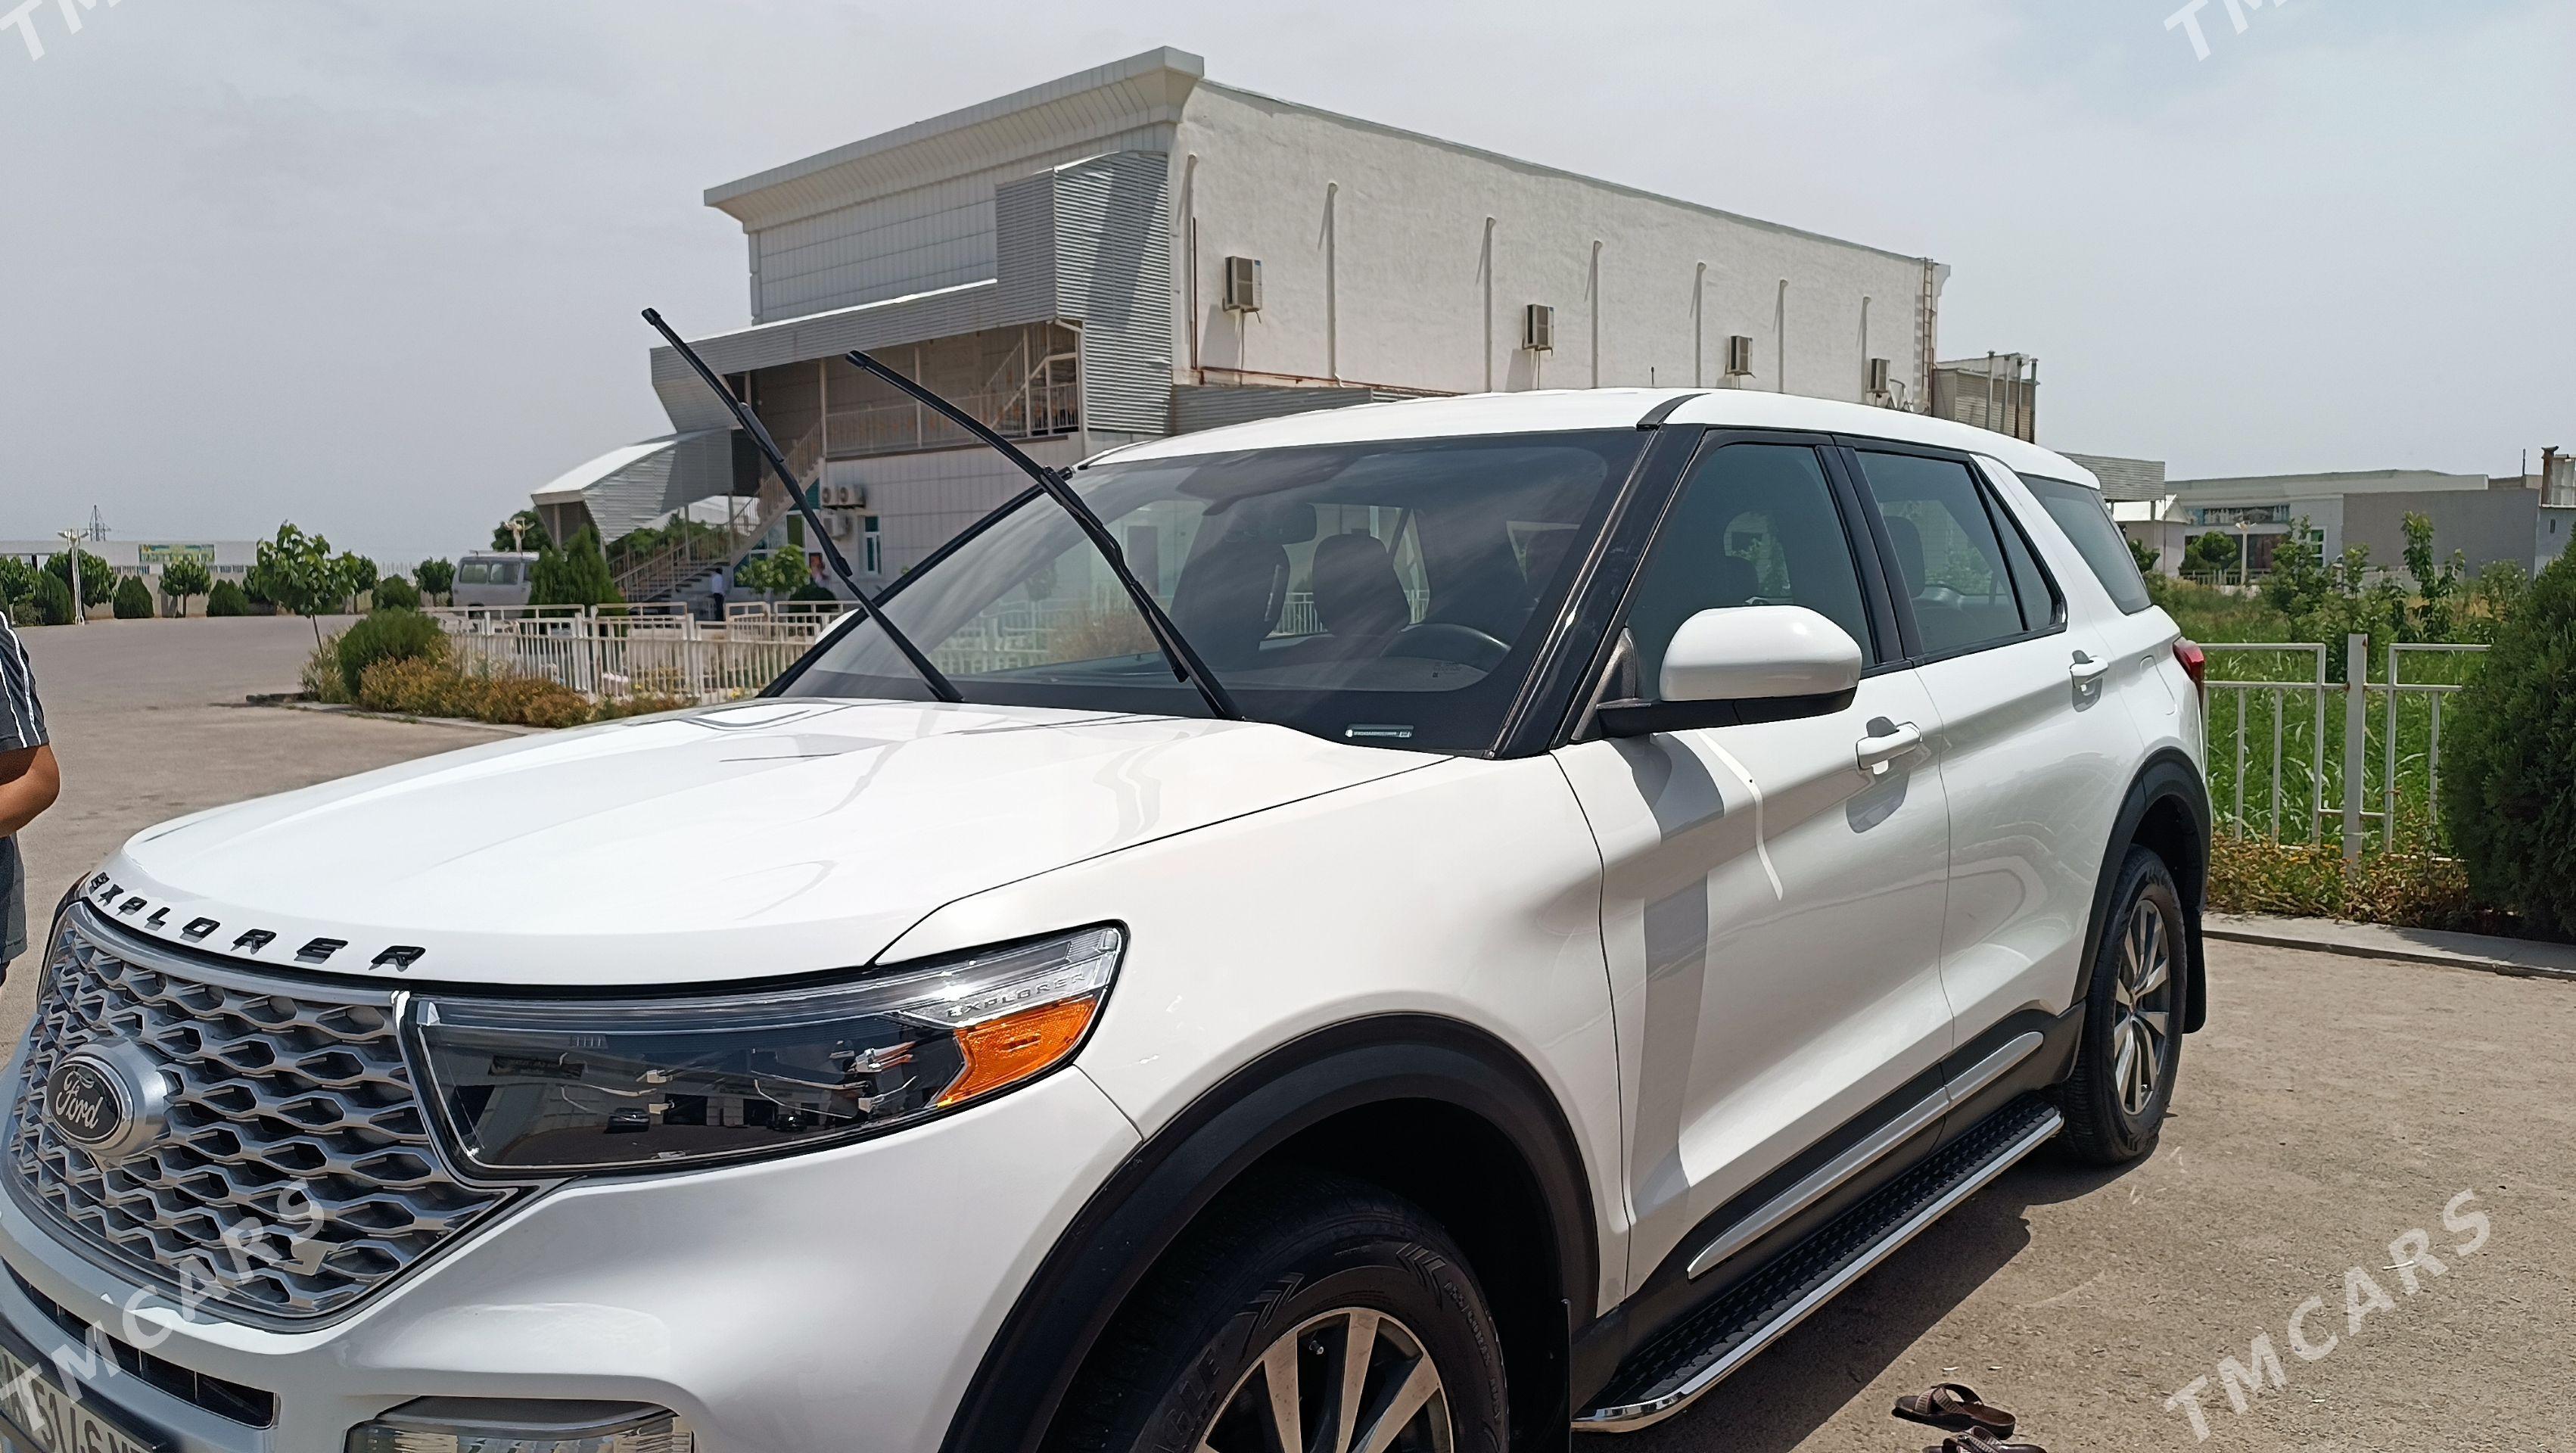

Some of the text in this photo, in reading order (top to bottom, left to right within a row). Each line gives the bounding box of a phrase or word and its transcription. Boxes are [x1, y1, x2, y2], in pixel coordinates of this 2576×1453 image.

[89, 872, 426, 969] EXPLORER
[947, 972, 1085, 1017] EXPLORER
[55, 1071, 104, 1129] Ford
